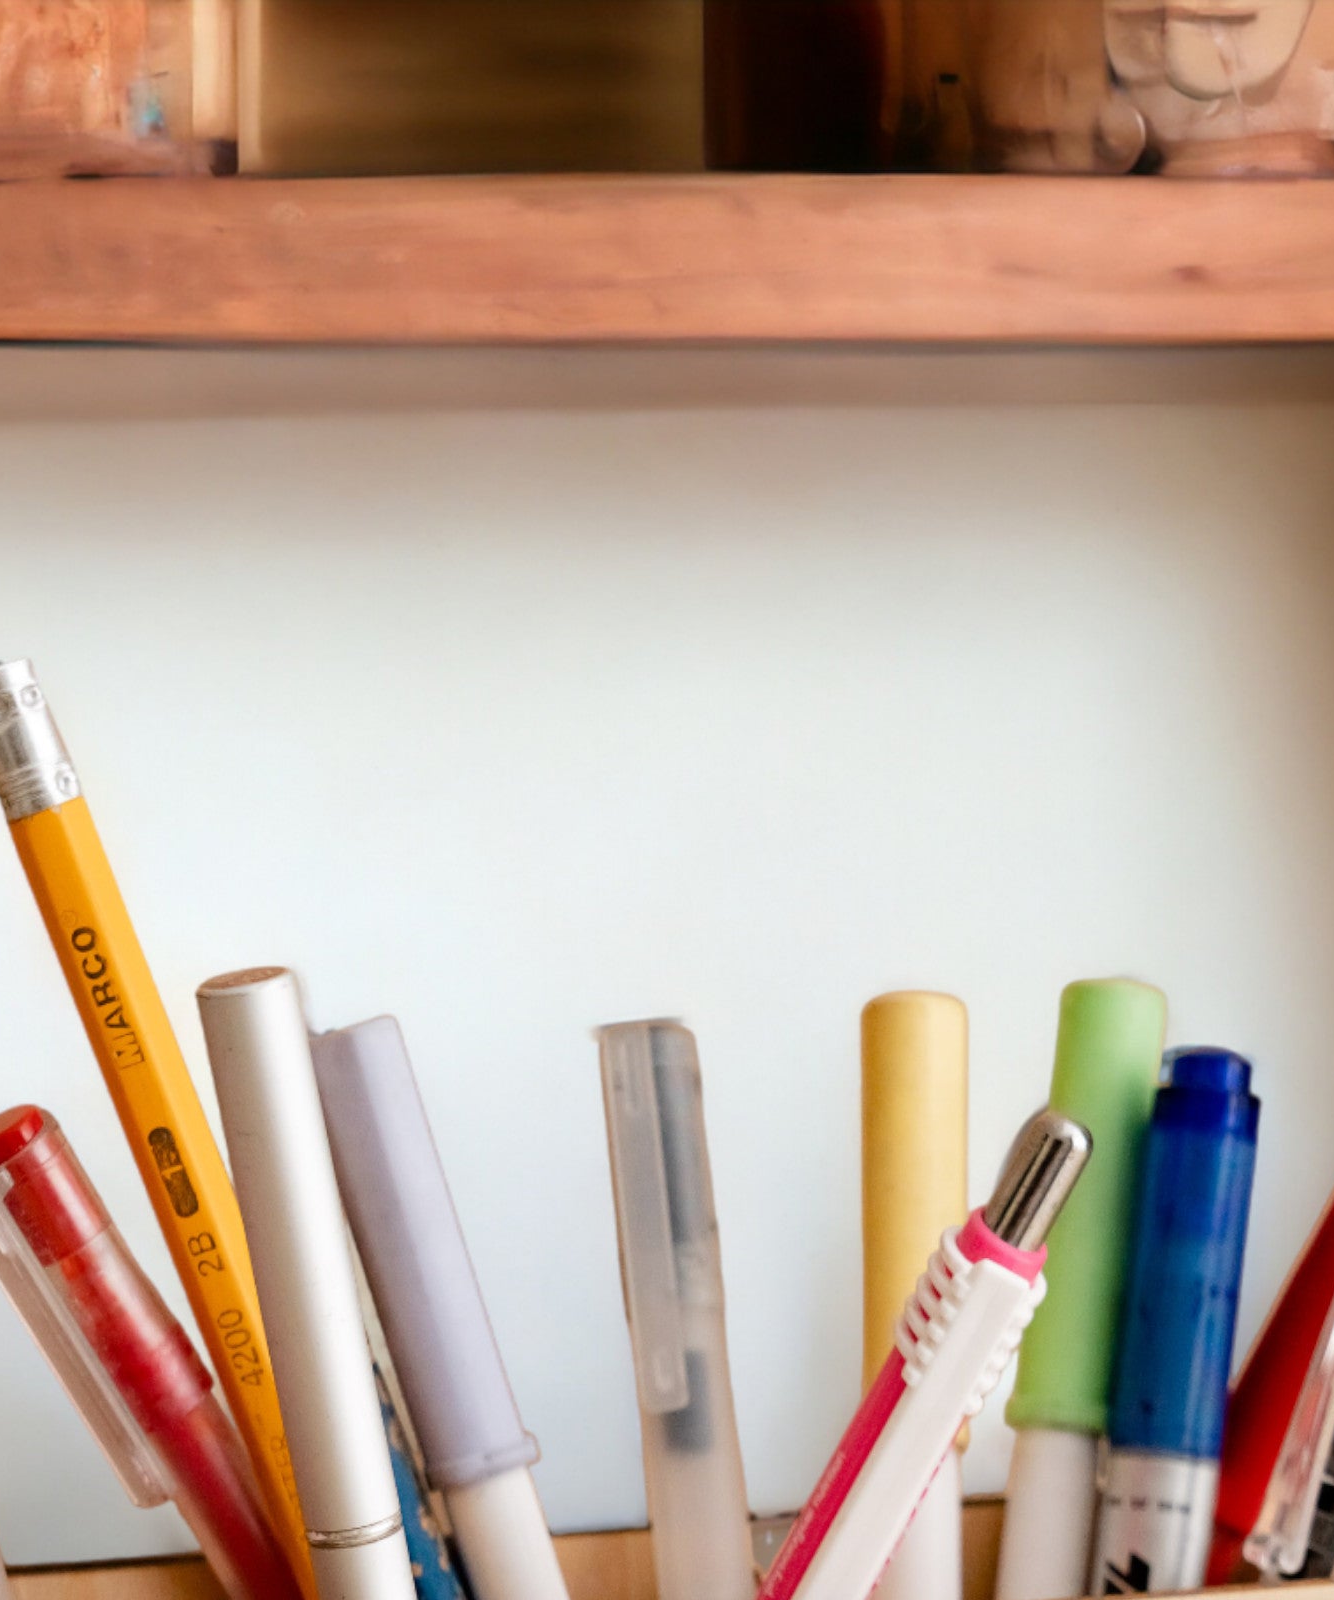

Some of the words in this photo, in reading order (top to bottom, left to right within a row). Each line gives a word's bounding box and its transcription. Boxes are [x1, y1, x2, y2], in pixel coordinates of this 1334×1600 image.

[71, 926, 146, 1070] MARCO
[187, 1231, 225, 1277] 2B
[217, 1308, 265, 1387] 4200
